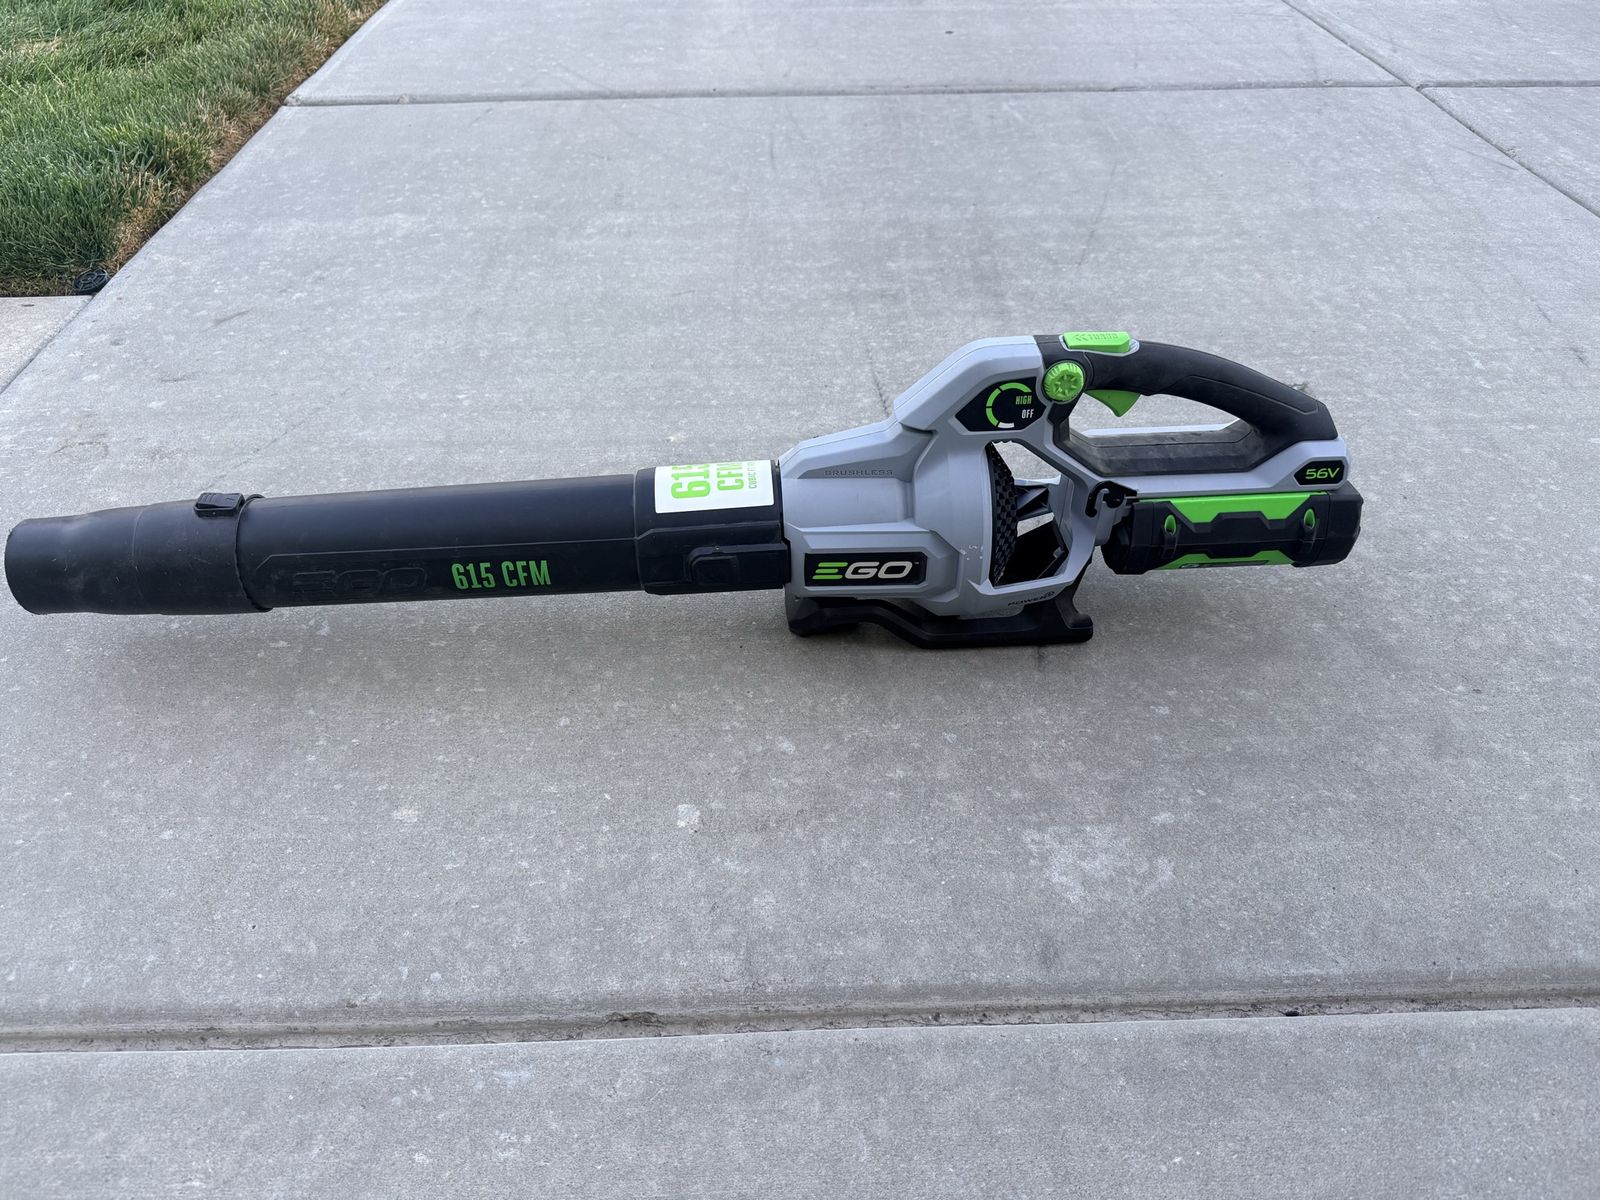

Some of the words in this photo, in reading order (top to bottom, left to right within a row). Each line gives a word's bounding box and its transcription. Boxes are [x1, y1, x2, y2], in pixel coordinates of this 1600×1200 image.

[1015, 395, 1032, 405] HIGH
[1021, 409, 1035, 419] OFF
[1305, 467, 1340, 480] 56V
[451, 562, 496, 590] 615
[501, 559, 551, 588] CFM
[812, 561, 914, 579] EGO
